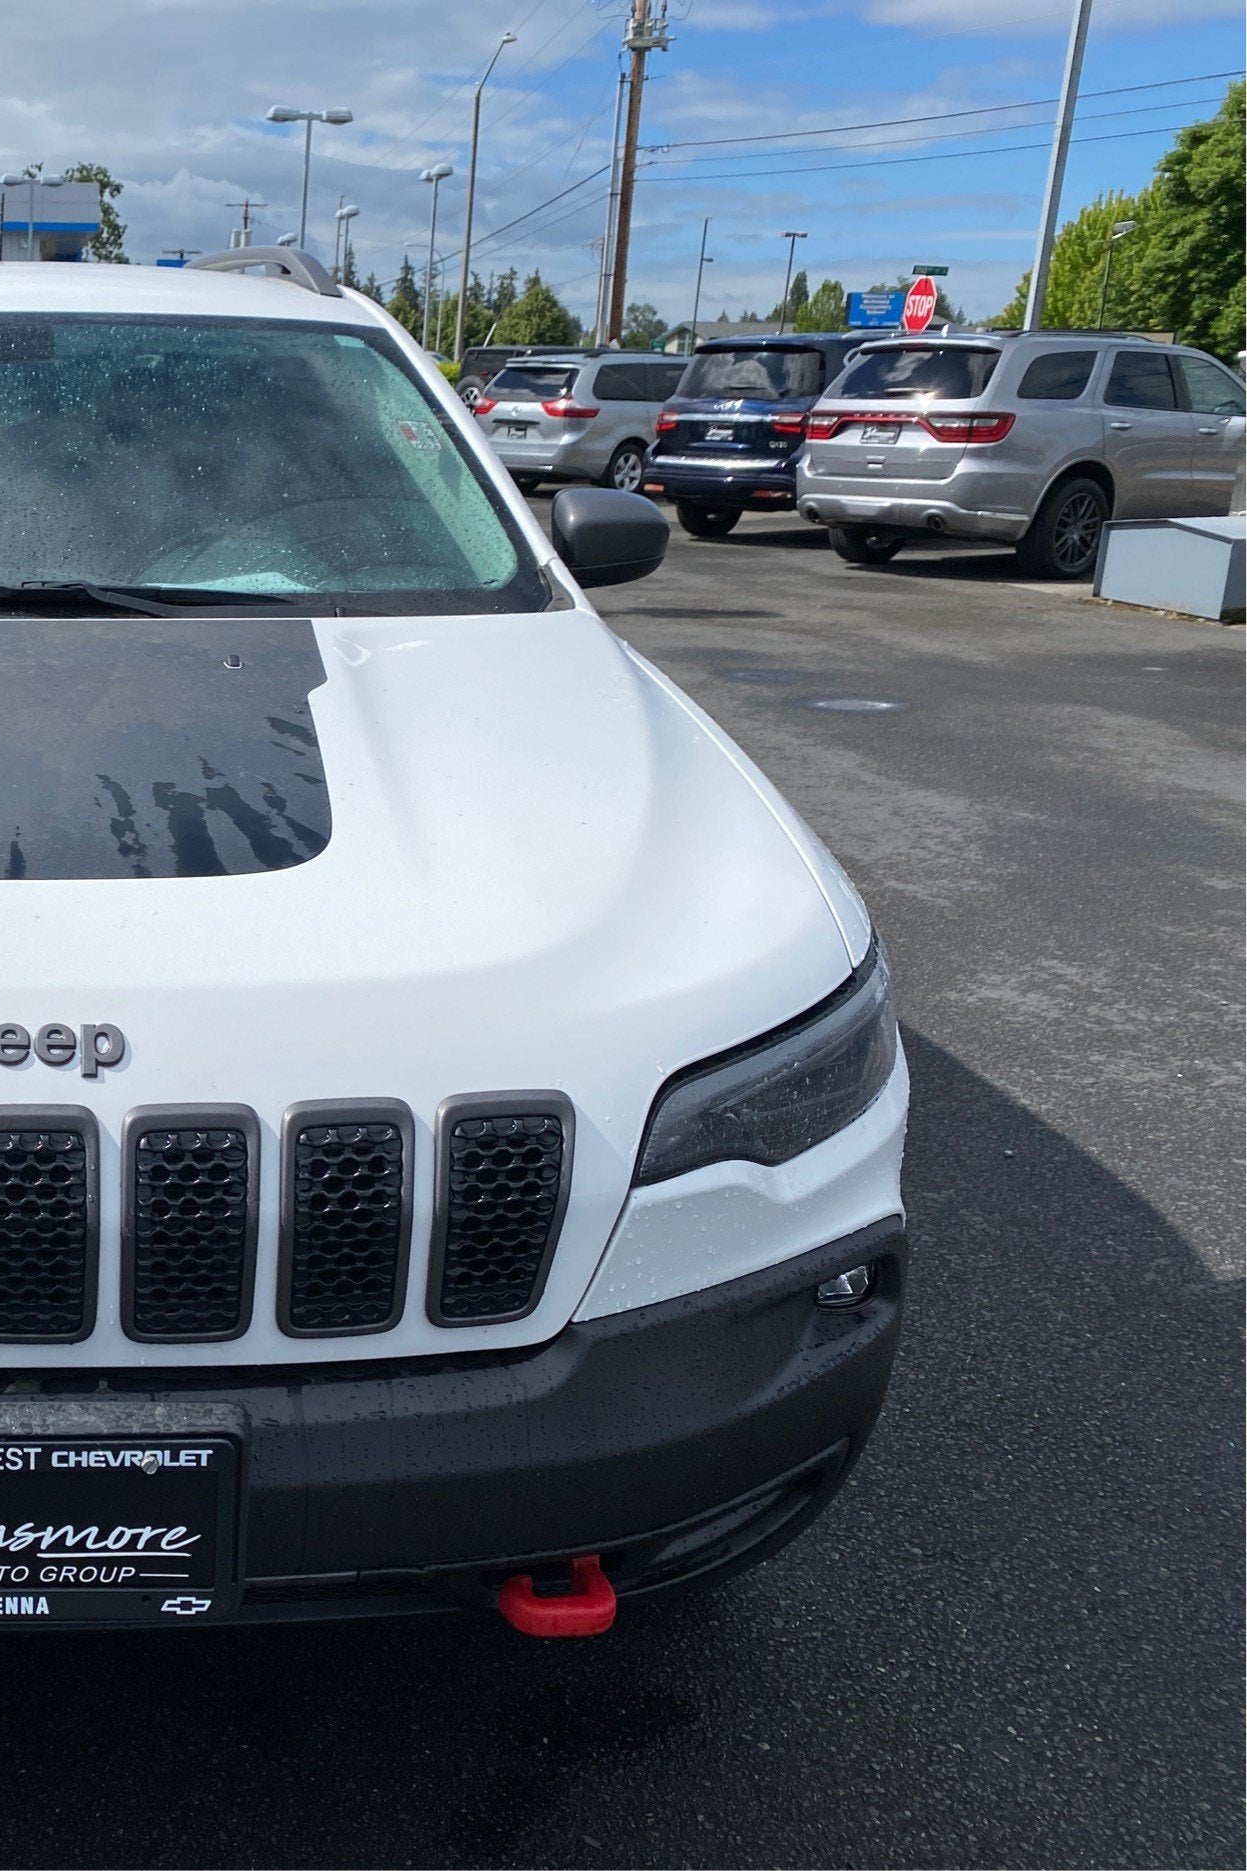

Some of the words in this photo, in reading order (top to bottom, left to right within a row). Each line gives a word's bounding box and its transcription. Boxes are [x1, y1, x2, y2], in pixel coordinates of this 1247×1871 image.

[906, 294, 933, 317] STOP
[51, 1449, 214, 1469] CHEVROLET
[39, 1565, 136, 1583] GROUP
